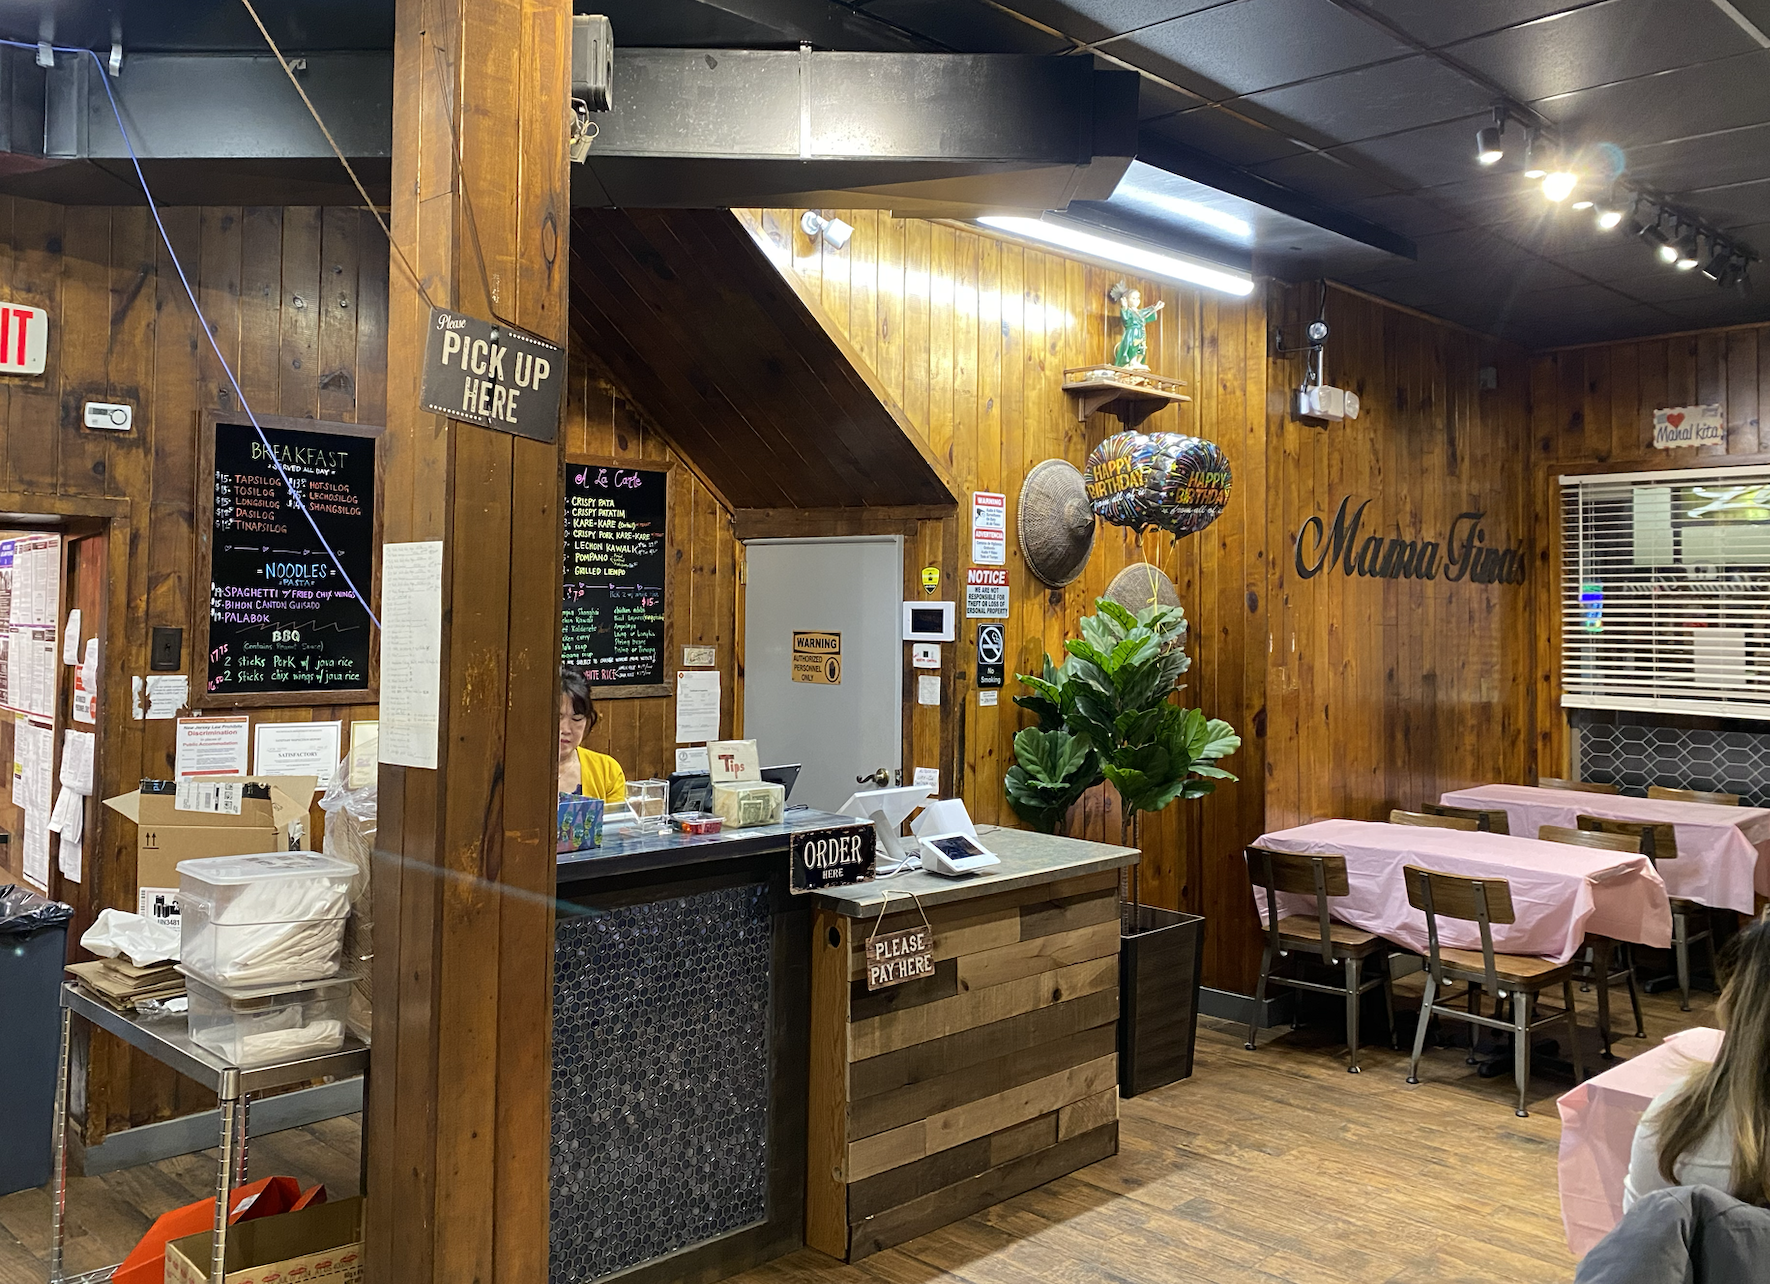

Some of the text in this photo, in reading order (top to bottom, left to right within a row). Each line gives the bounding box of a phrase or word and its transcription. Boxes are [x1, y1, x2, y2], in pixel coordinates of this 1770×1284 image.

[436, 314, 466, 330] Please
[442, 330, 550, 390] PICK UP
[462, 376, 520, 424] HERE
[1656, 423, 1720, 443] Mahal kita
[252, 442, 348, 468] BREAKFAST
[272, 464, 301, 472] SRVED
[1092, 455, 1132, 481] HAPPY
[234, 474, 281, 486] TAPSILOG
[594, 468, 608, 488] La
[615, 470, 642, 488] Carte
[1086, 468, 1144, 499] BIRTHDAY
[1188, 471, 1227, 488] HAPPY
[234, 486, 274, 497] TOSILOG
[310, 481, 350, 493] HOTSILOG
[309, 492, 358, 504] LECHOSILOG
[572, 496, 615, 507] CRISPY PATA
[1176, 487, 1231, 505] BIRTHDAY
[236, 497, 280, 509] LONGSILOG
[310, 502, 361, 515] SHANGSILOG
[236, 508, 274, 520] DASILOG
[572, 508, 597, 517] CRISPY
[234, 520, 288, 533] TINAPSILOG
[573, 518, 616, 528] KARE-KARE
[573, 530, 596, 539] CRISPY
[599, 531, 614, 540] PORK
[616, 532, 650, 540] KARE-KARE
[1295, 494, 1444, 580] Mama
[574, 541, 603, 550] LECHON
[575, 552, 608, 563] POMPANO
[266, 562, 327, 579] NOODLES
[574, 566, 602, 576] GRILLED
[282, 578, 310, 586] PASTA
[968, 570, 1006, 584] NOTICE
[223, 586, 278, 598] SPAGHETTI
[292, 590, 314, 598] FRIED
[316, 590, 332, 600] CHIX
[334, 590, 356, 599] WINGS
[225, 600, 320, 610] BIHON CANTON GUISADO
[225, 612, 270, 623] PALABOK
[272, 630, 300, 642] BBQ
[797, 638, 836, 649] WARNING
[224, 656, 231, 666] 2
[315, 656, 334, 670] java
[338, 656, 353, 667] rice
[794, 655, 822, 663] AUTHORIZED
[794, 664, 822, 672] PERSONNEL
[224, 670, 232, 681] 2
[293, 670, 314, 684] wings
[324, 670, 342, 684] java
[345, 670, 360, 680] rice
[601, 669, 616, 680] RICE
[981, 676, 1001, 684] Smoking
[718, 755, 745, 779] Tips
[804, 834, 863, 869] ORDER
[822, 868, 844, 880] HERE
[875, 934, 925, 960] PLEASE
[871, 955, 932, 986] PAY HERE
